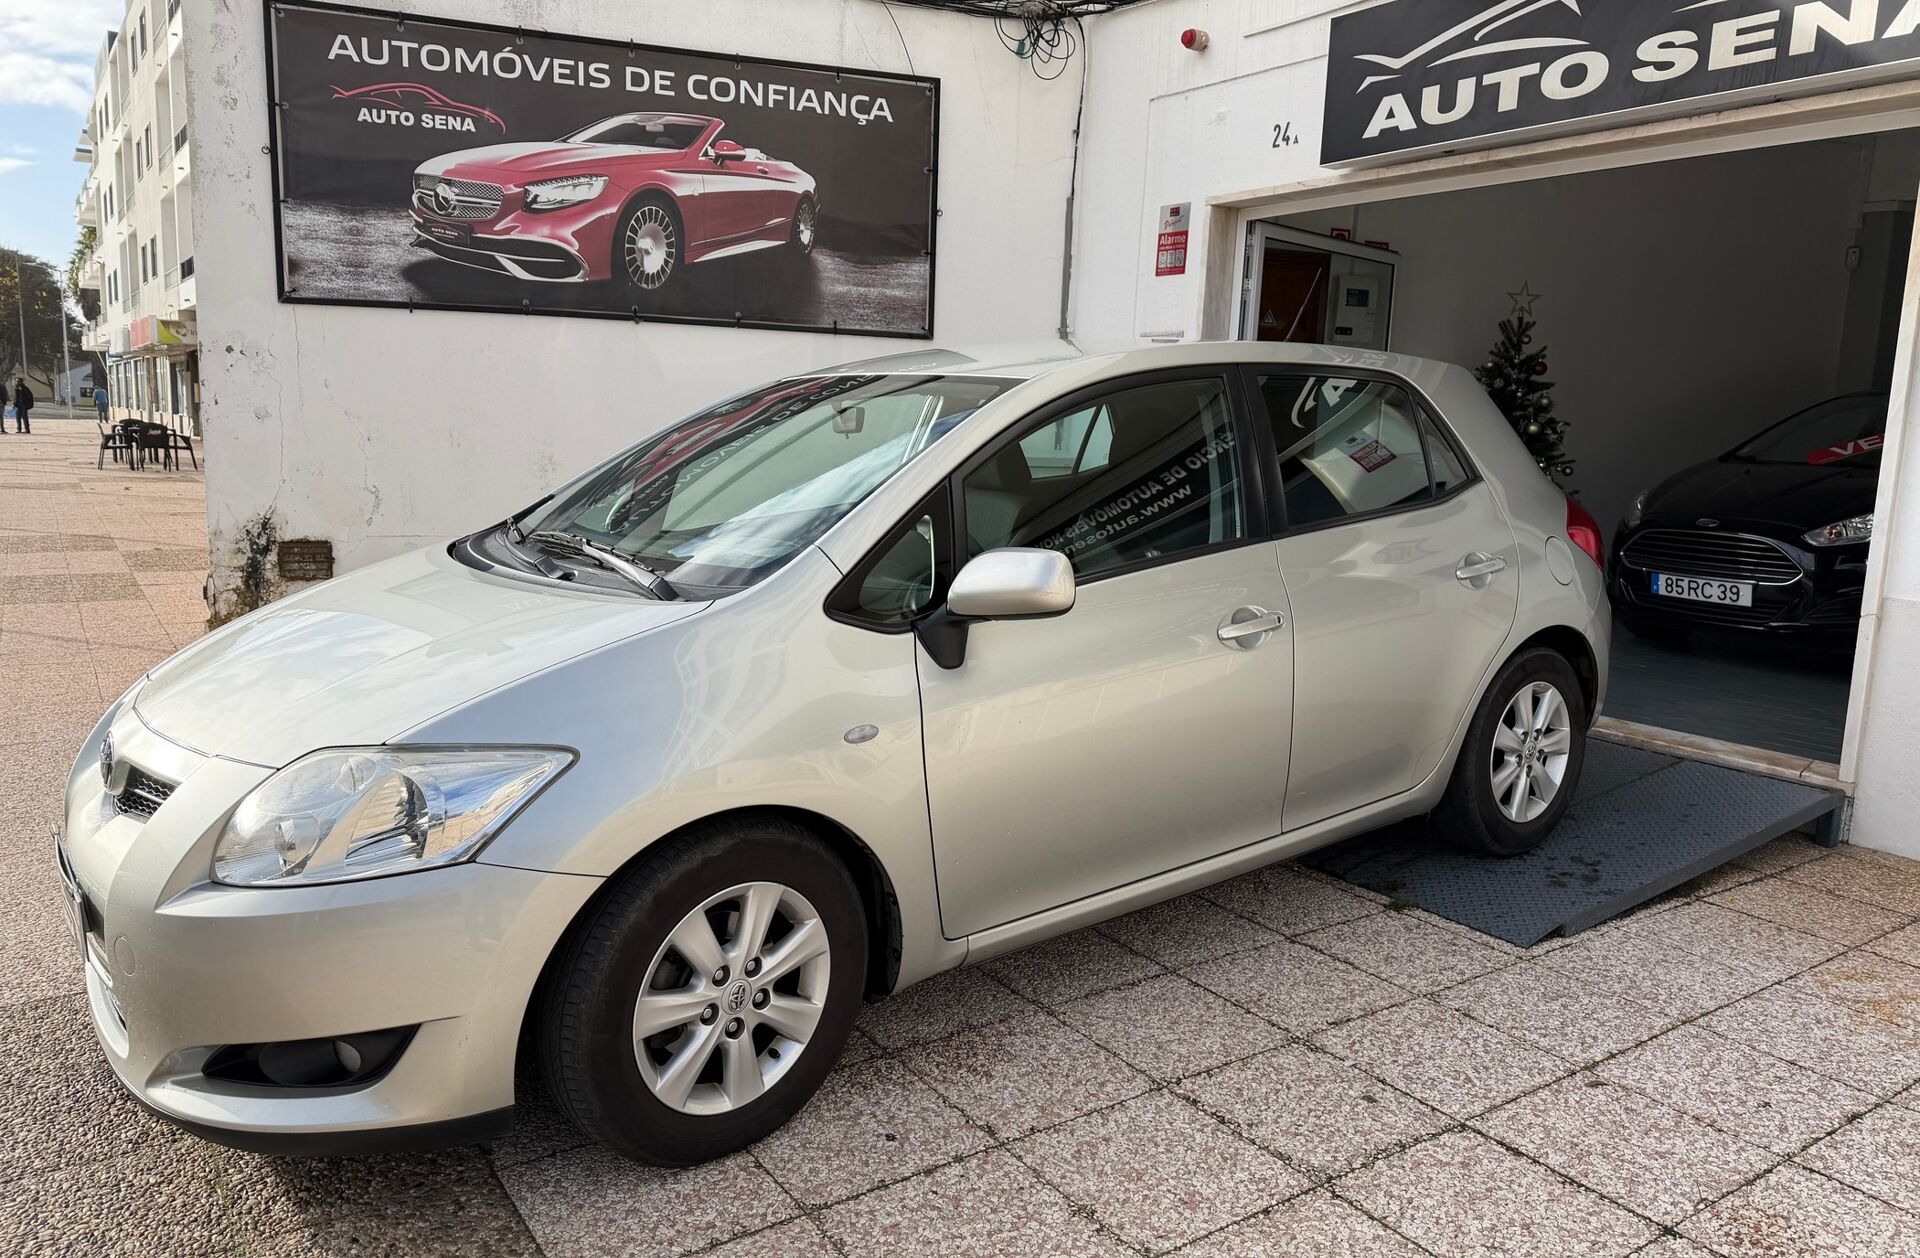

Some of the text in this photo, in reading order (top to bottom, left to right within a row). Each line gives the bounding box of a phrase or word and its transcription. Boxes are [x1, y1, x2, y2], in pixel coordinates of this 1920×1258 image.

[328, 34, 893, 125] AUTOMÓVEIS DE CONFIANÇA
[1362, 51, 1609, 138] AUTO
[357, 107, 476, 132] AUTO SENA
[1160, 234, 1186, 246] Alarme
[1829, 435, 1883, 455] VE
